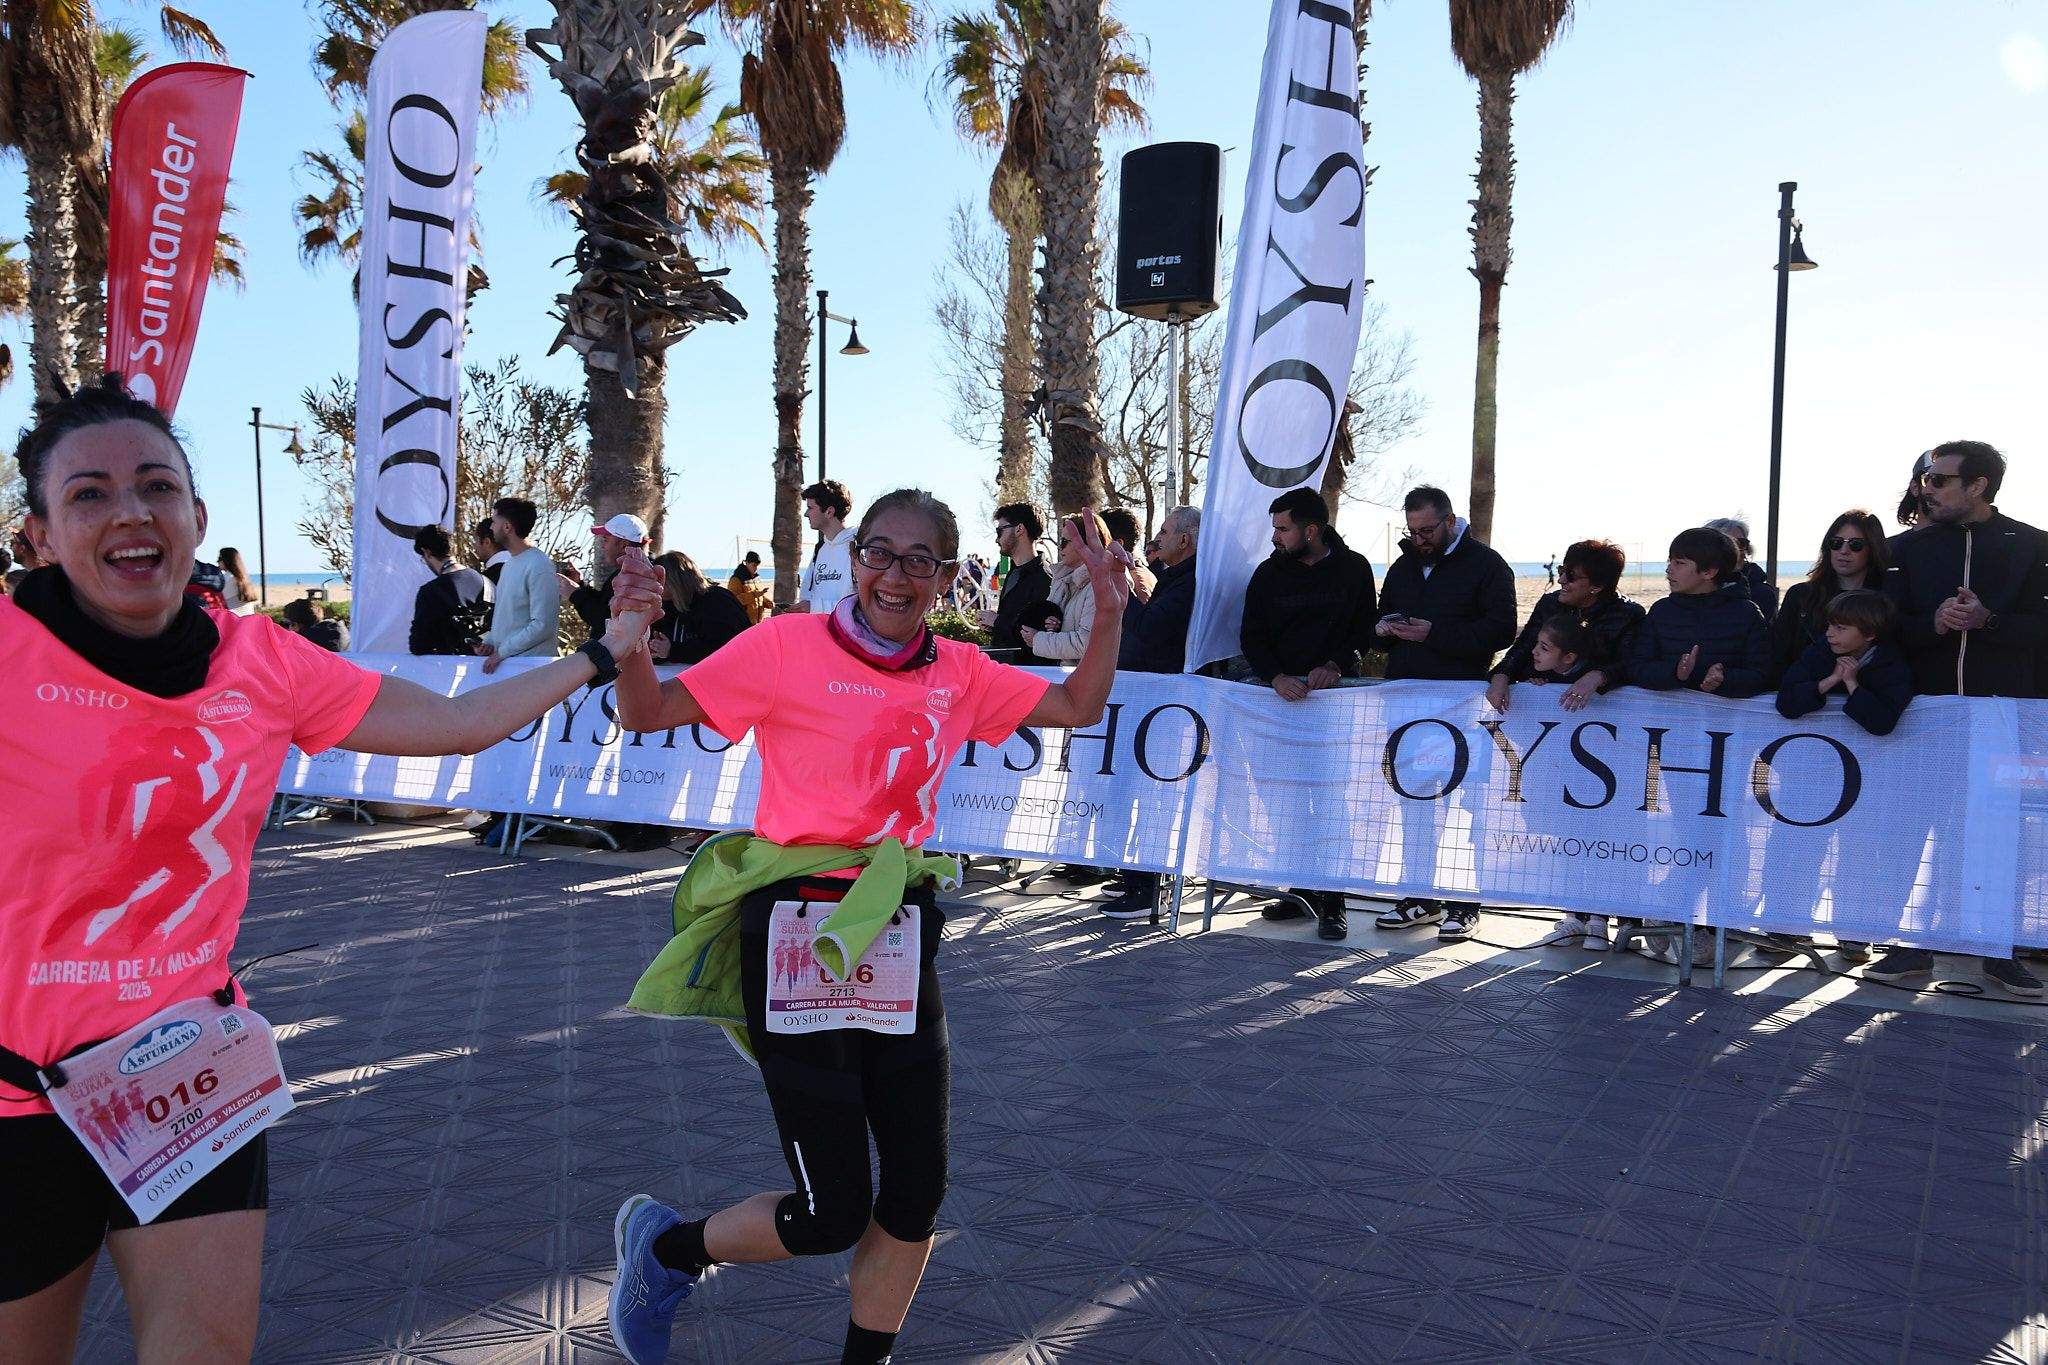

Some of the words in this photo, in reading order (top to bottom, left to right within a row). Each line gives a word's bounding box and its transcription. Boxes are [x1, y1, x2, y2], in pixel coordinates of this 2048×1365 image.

[131, 121, 198, 367] Santander
[1237, 0, 1365, 489] OYSH
[375, 93, 461, 540] OYSHO
[37, 683, 129, 710] OYSHO
[828, 681, 886, 699] OYSHO
[959, 703, 1211, 783] SHO
[549, 764, 665, 785] WWW.OYSO.COM
[1382, 718, 1862, 828] OYSHO
[952, 792, 1104, 818] WWW.OYSHO.COM
[1493, 833, 1713, 870] WWW.OYSHO.COM
[28, 960, 111, 985] CARRERA
[117, 959, 144, 980] DE
[118, 981, 152, 1001] 2025
[786, 1000, 816, 1010] CARRERA
[838, 999, 861, 1007] MUJER
[866, 1002, 898, 1010] VALENCIA
[829, 987, 855, 997] 2713
[783, 1013, 829, 1027] OYSHO
[856, 1013, 900, 1027] Santander
[127, 1029, 198, 1072] ASTURIANA
[145, 1068, 219, 1124] 016
[136, 1155, 169, 1182] CARRERA
[167, 1145, 180, 1158] DE
[179, 1136, 192, 1149] LA
[190, 1116, 219, 1141] MUJER
[222, 1089, 263, 1117] VALENCIA
[170, 1107, 203, 1136] 2700
[146, 1160, 194, 1202] OYSHO
[223, 1105, 272, 1144] Santander
